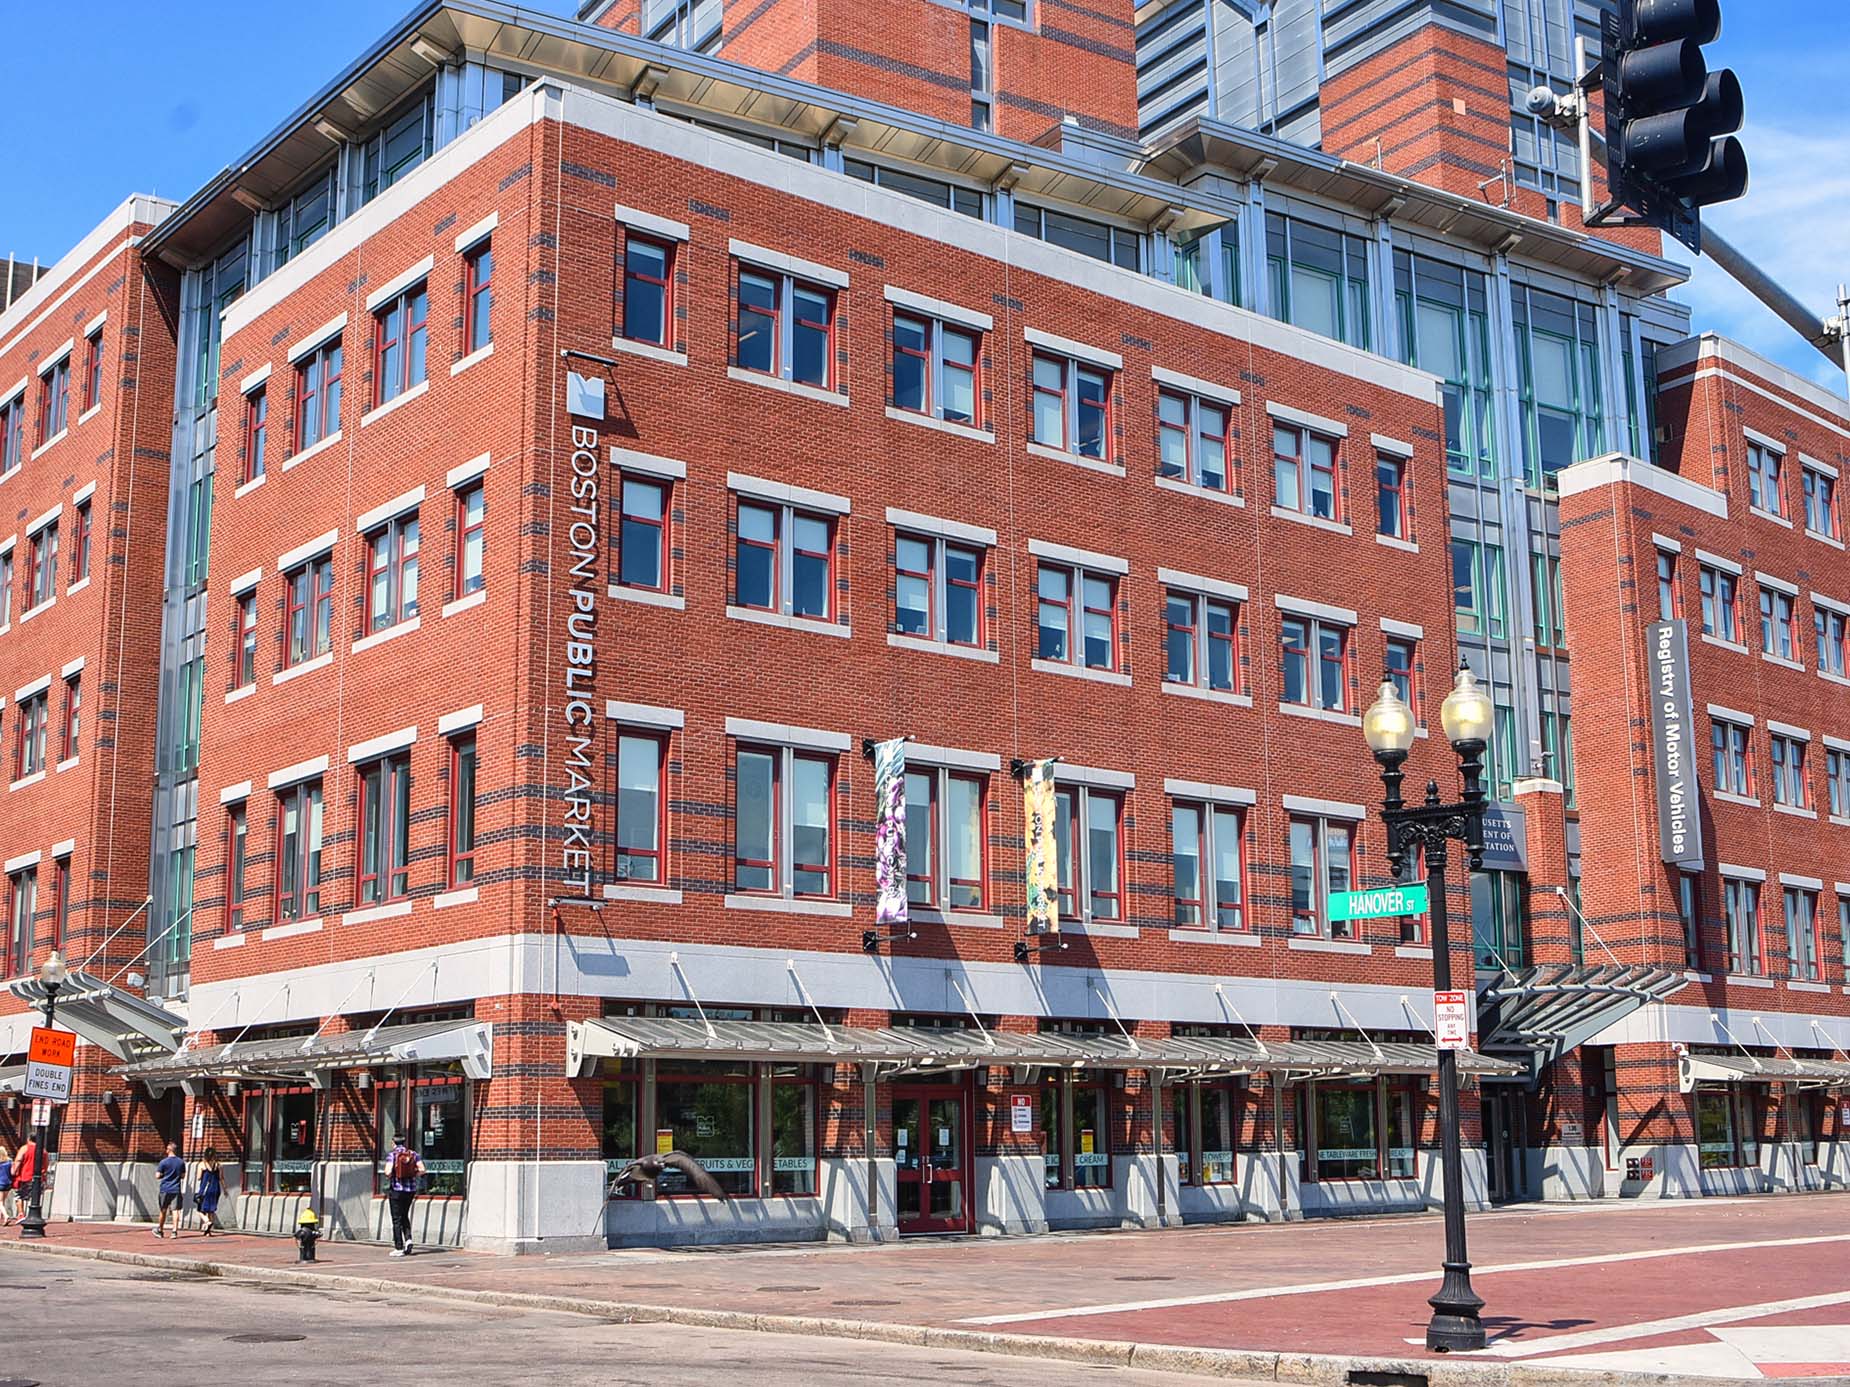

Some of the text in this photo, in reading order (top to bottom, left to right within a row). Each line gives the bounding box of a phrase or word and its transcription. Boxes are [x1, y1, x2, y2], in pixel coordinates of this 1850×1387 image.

[563, 425, 598, 896] BOSTON PUBLIC MARKET
[1658, 627, 1688, 855] Registry of Motor Vehicles
[1500, 832, 1511, 840] OF
[1484, 842, 1514, 852] TATION
[1349, 892, 1415, 915] HANOVER ST
[1435, 994, 1464, 1002] TOW ZONE
[1446, 1005, 1455, 1013] NO
[1438, 1013, 1464, 1021] STOPPING
[35, 1034, 71, 1048] END ROAD
[42, 1048, 60, 1057] WORK
[35, 1068, 63, 1080] DOUBLE
[28, 1079, 66, 1093] FINES END
[726, 1159, 733, 1169] &
